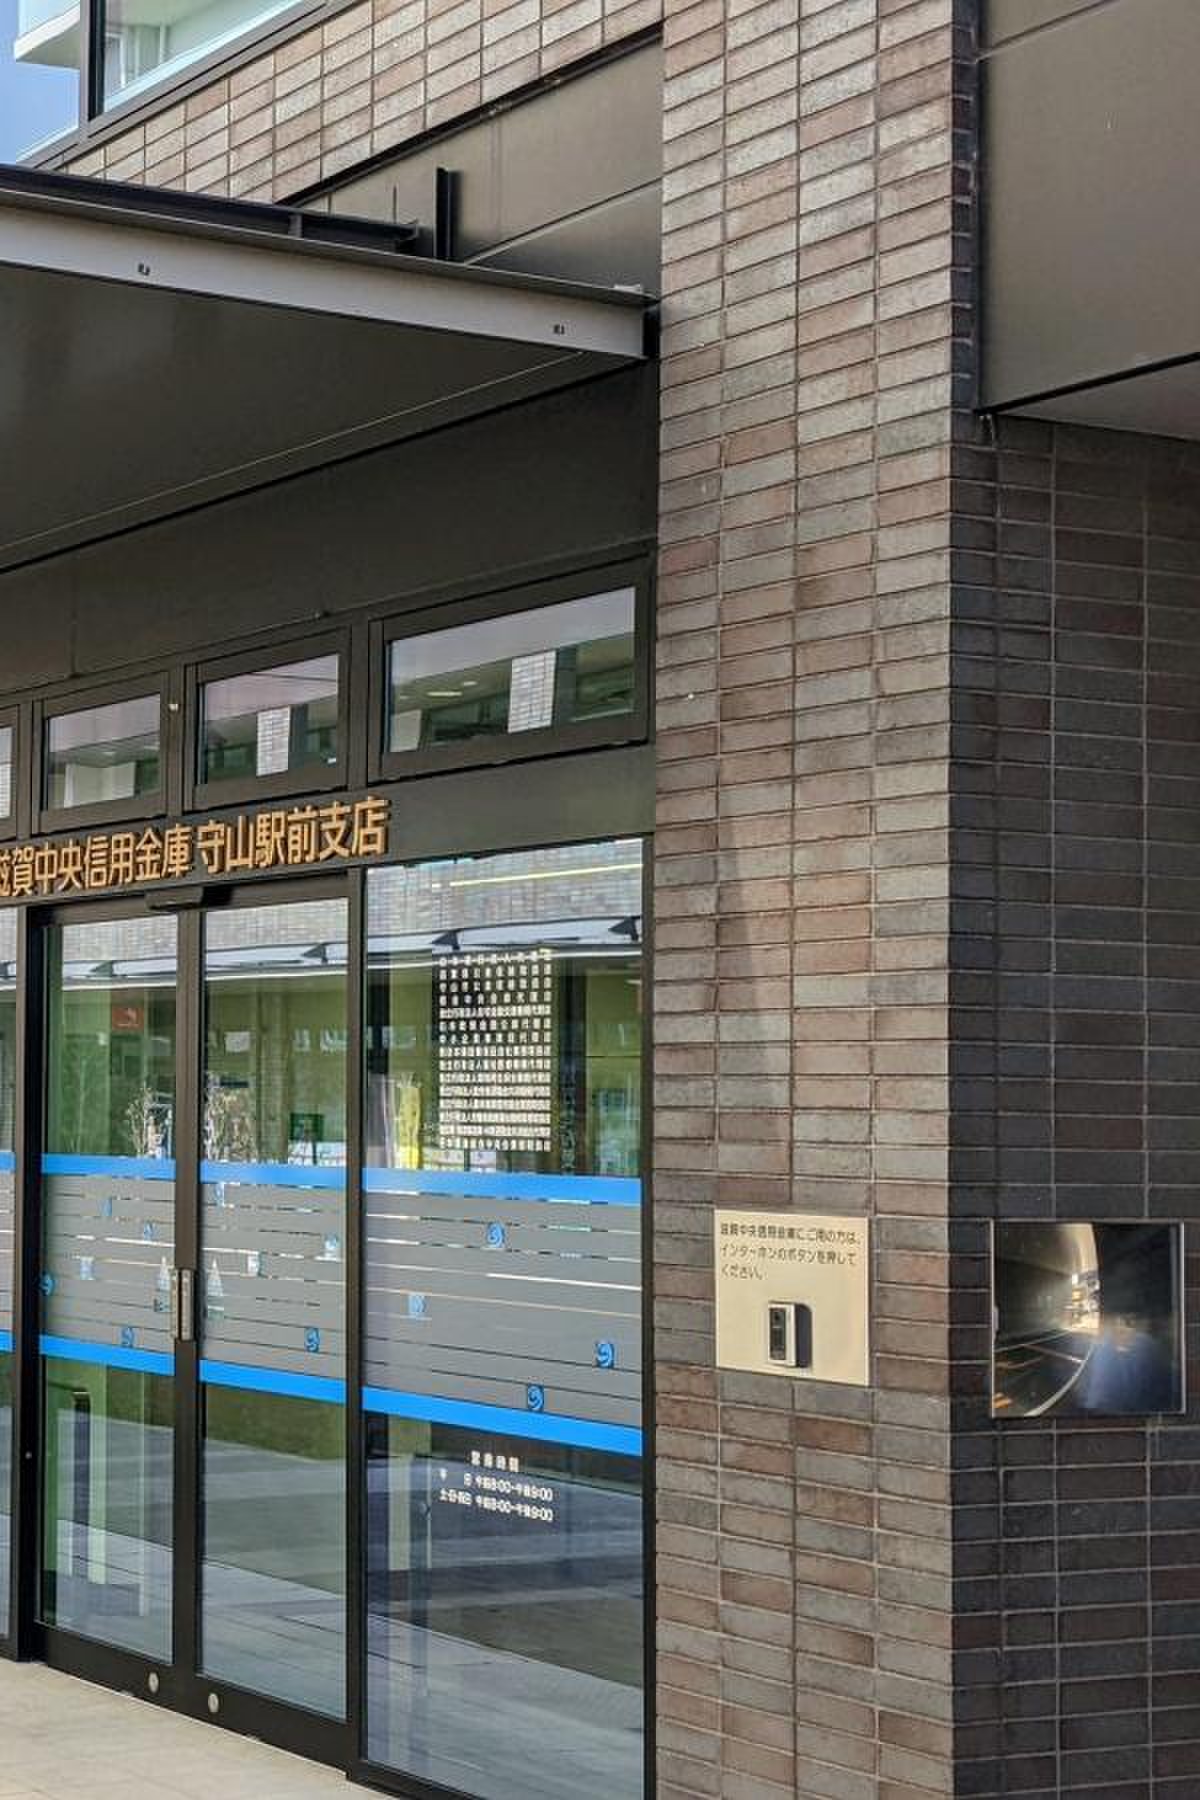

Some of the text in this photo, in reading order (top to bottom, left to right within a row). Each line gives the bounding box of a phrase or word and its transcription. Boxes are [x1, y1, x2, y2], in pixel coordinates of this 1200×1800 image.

[197, 796, 390, 875] 守山駅前支店
